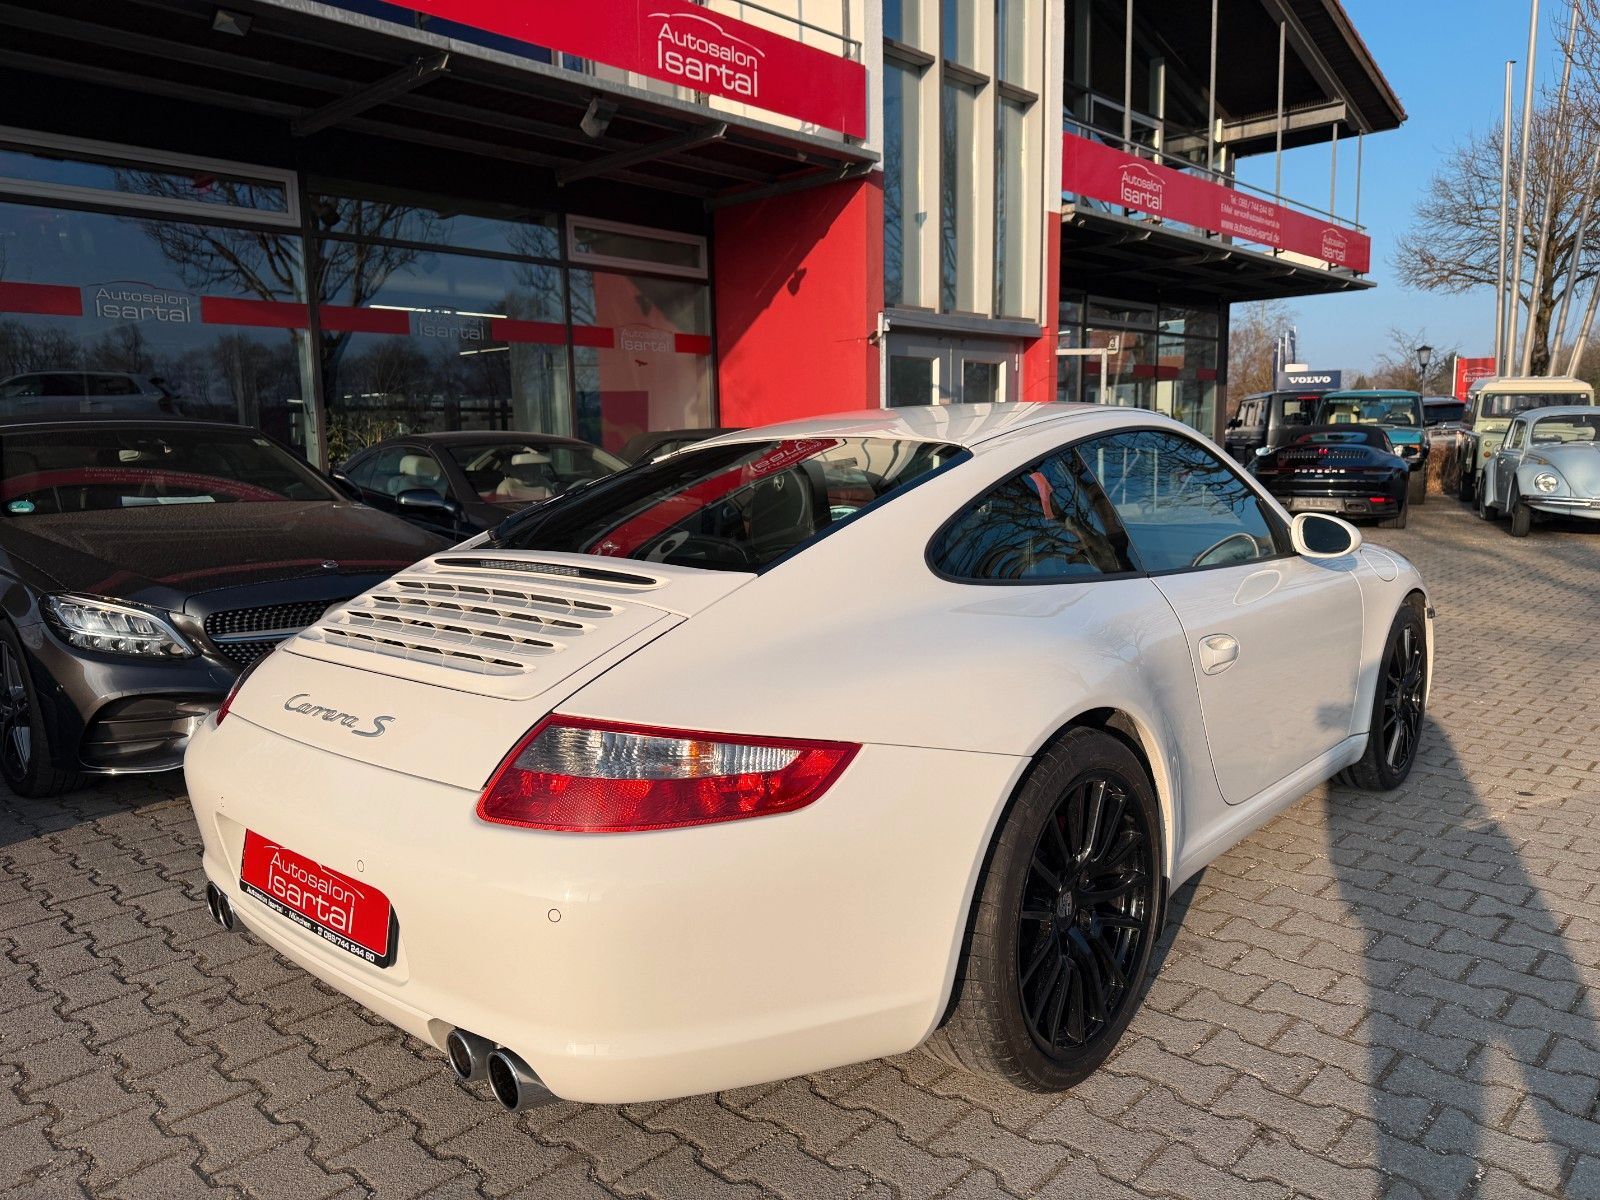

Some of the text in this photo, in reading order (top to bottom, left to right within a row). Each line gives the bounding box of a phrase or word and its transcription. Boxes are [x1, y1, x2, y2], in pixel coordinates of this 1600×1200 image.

[658, 23, 758, 70] Autosalon
[657, 40, 758, 98] Isartal
[1122, 170, 1162, 193] Autosalon
[1121, 182, 1162, 211] Isartal
[1321, 242, 1346, 262] Isartal
[96, 288, 190, 306] Autosalon
[96, 299, 191, 323] Isartal
[418, 312, 484, 341] Isartal
[620, 335, 673, 353] Isartal
[1288, 375, 1332, 384] VOLVO
[284, 693, 396, 738] Carrera S
[270, 851, 355, 906] Autosalon
[267, 864, 354, 935] Isartal
[246, 885, 268, 904] Autosalon
[288, 910, 312, 929] München
[350, 944, 365, 957] 244
